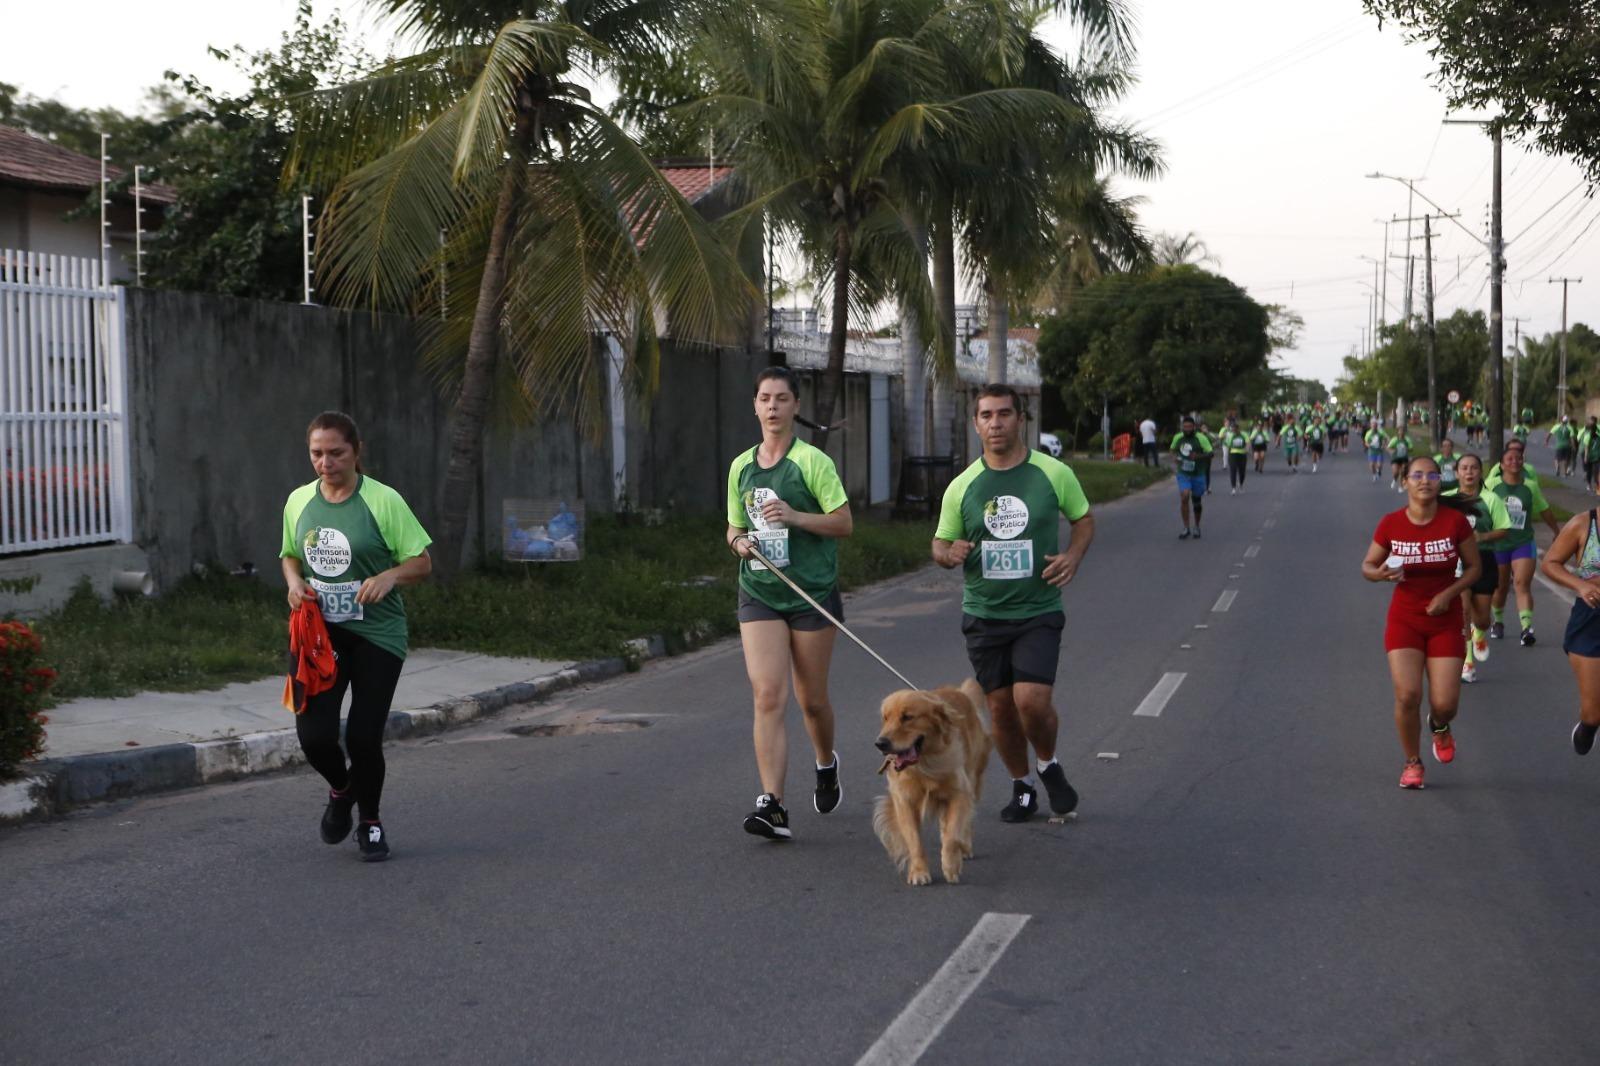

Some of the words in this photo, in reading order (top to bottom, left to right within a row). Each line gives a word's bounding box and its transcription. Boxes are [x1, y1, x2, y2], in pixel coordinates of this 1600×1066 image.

[988, 512, 1027, 524] Defensoria
[999, 520, 1026, 529] Pública
[1391, 540, 1421, 555] PINK
[1424, 537, 1454, 554] GIRL
[307, 547, 349, 556] Defensoria
[319, 556, 350, 565] Pública
[991, 551, 1022, 570] 261
[319, 583, 353, 591] CORRIDA
